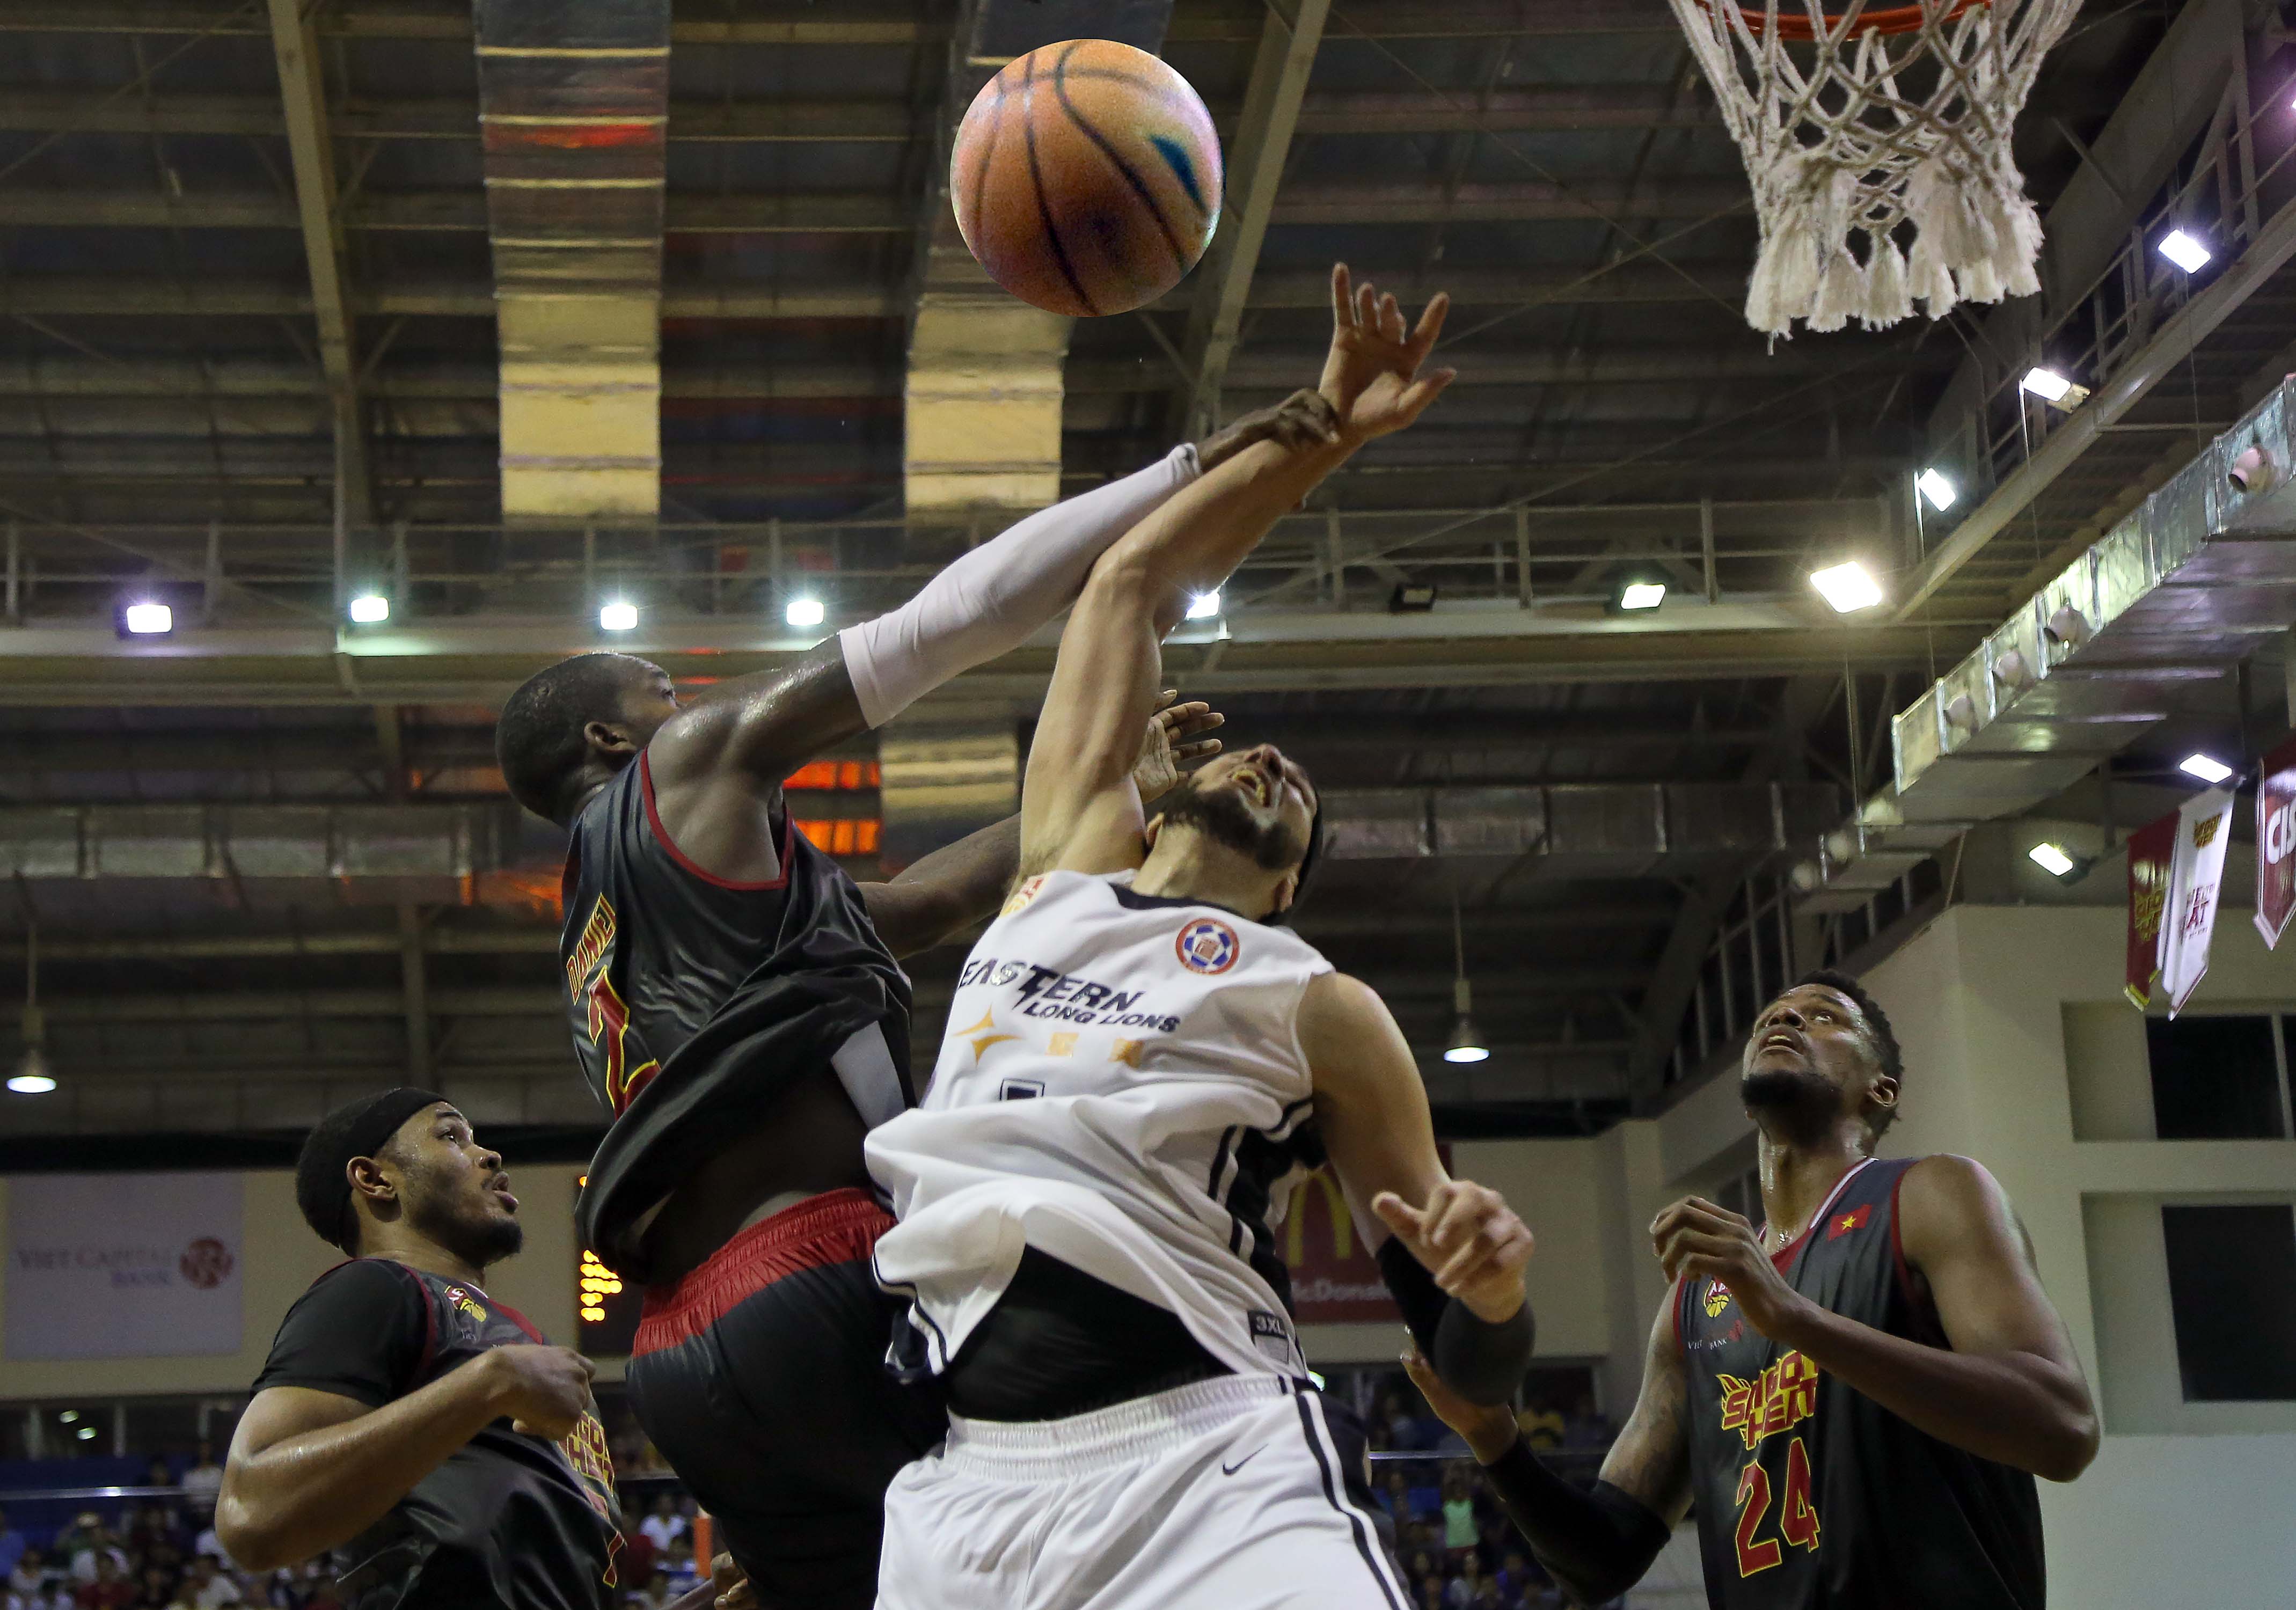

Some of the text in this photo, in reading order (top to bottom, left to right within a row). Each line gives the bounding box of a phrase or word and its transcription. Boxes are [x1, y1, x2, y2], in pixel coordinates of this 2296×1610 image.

[958, 958, 1146, 1011] EASTERN
[1023, 1002, 1180, 1033] LONG LIONS
[1736, 1436, 1820, 1578] 24
